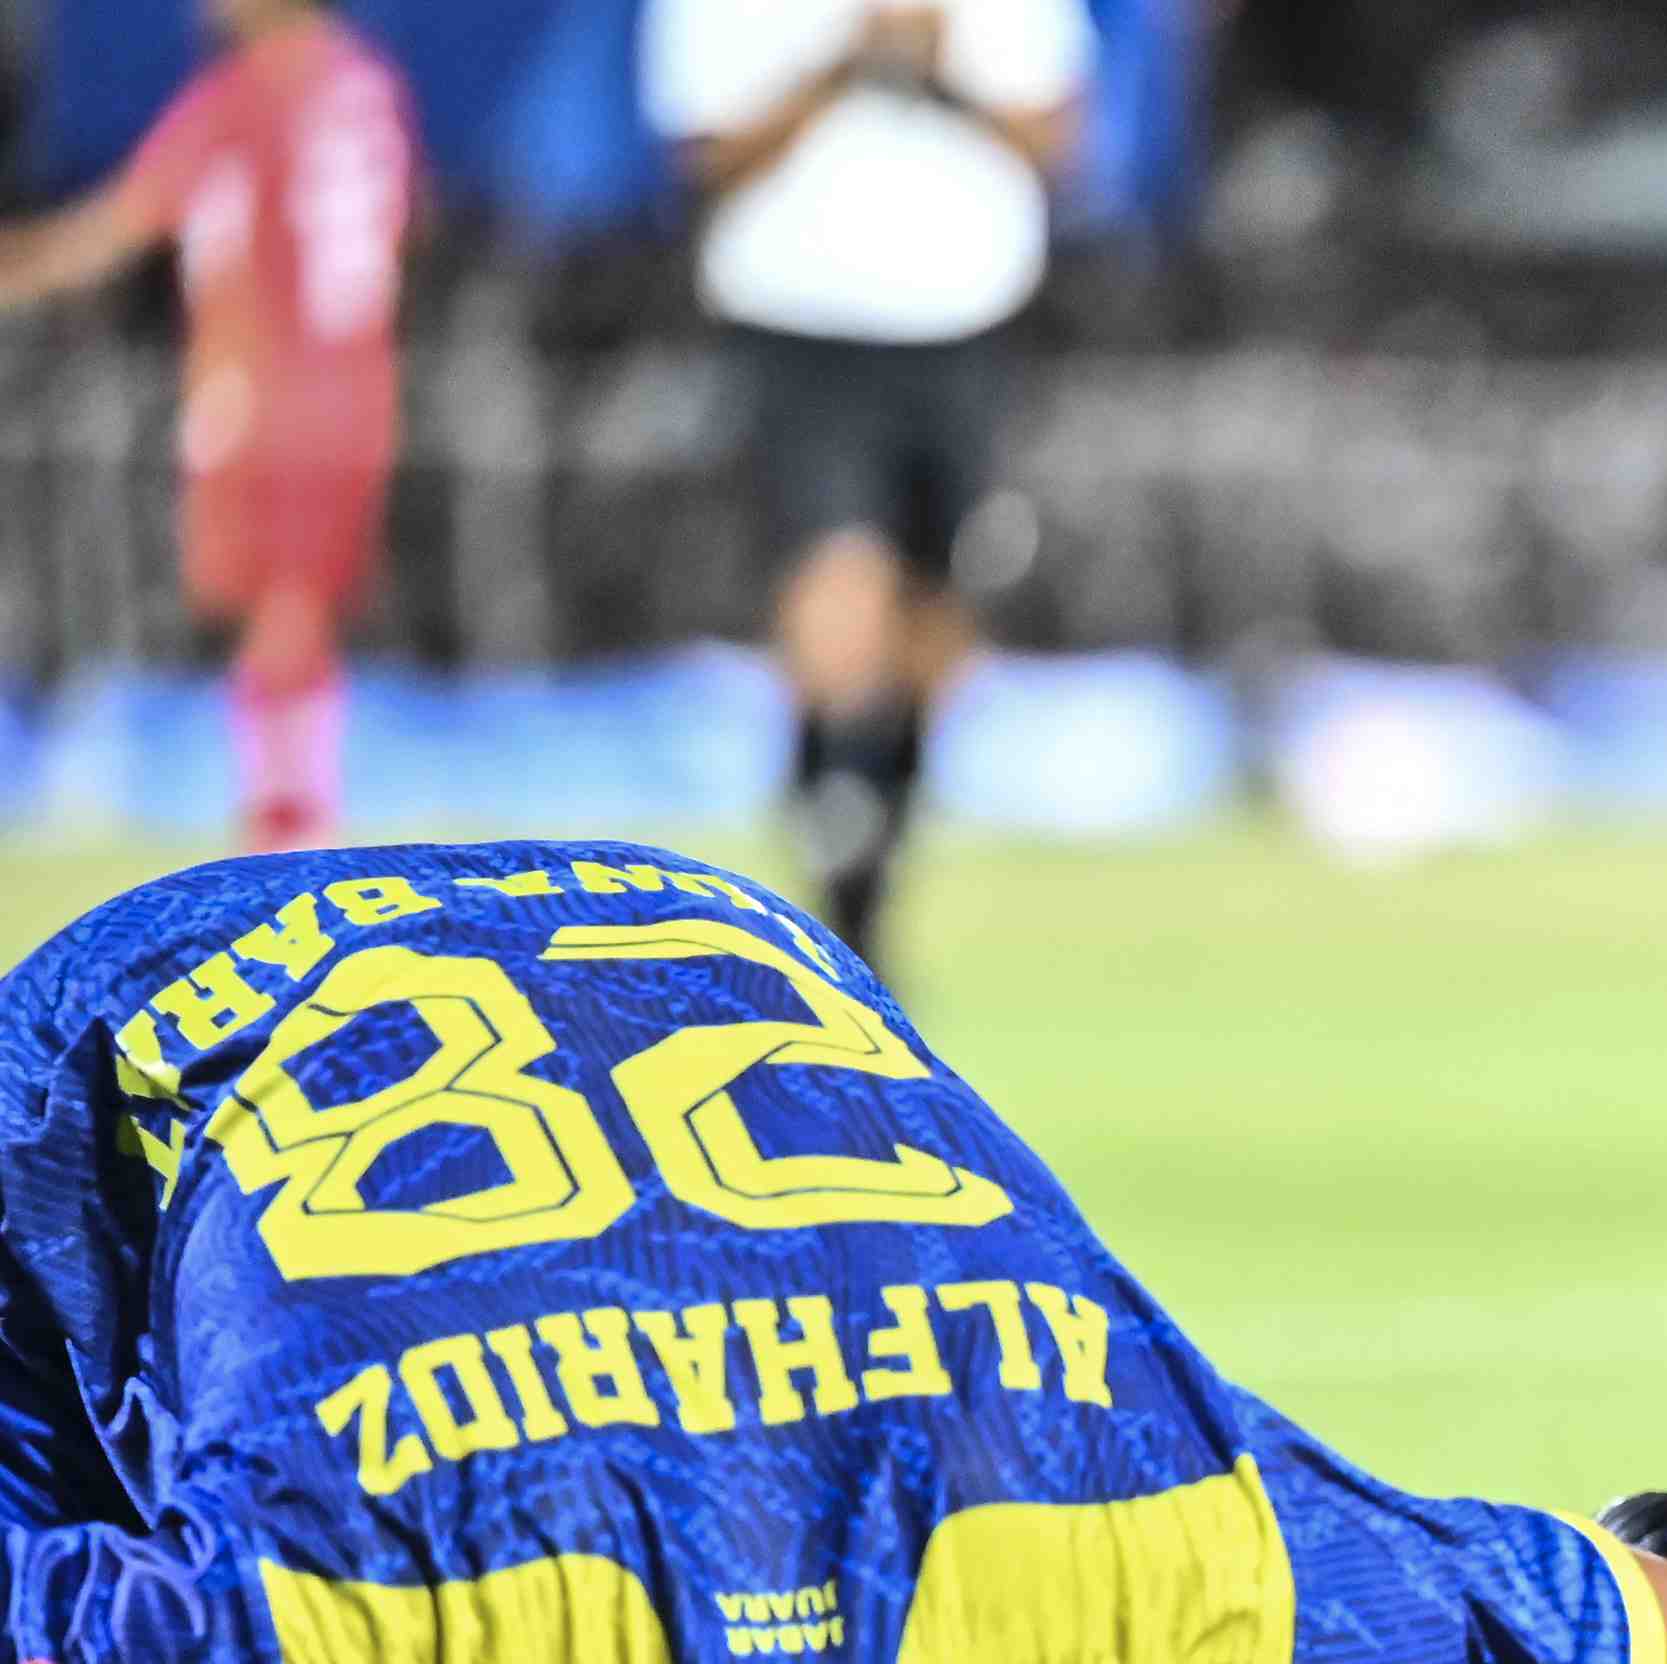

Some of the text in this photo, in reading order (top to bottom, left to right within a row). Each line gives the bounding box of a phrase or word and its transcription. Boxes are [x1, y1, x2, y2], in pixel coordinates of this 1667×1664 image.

[206, 919, 1014, 1281] 28
[317, 1280, 1113, 1496] ALFHARIDZ
[718, 1579, 840, 1622] JUARA
[728, 1616, 845, 1656] JABAR
